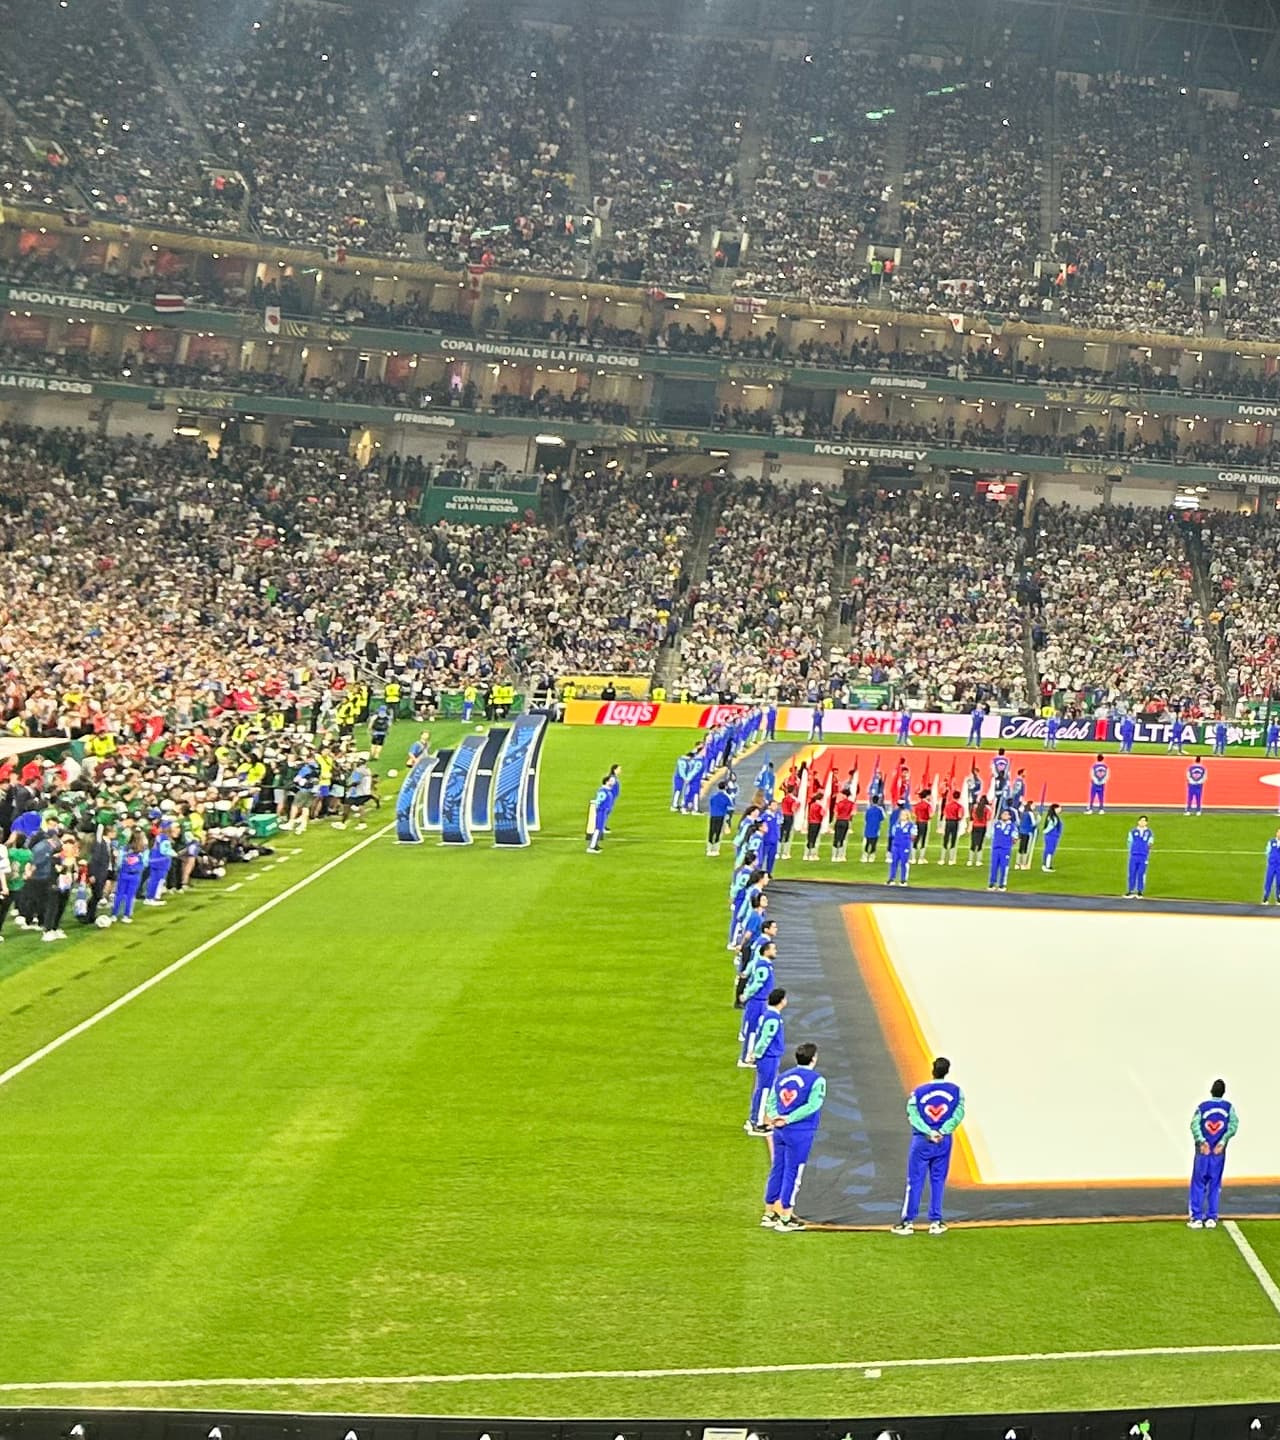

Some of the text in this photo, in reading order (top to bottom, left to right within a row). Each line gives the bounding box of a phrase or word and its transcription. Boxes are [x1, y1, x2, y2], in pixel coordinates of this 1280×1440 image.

[9, 289, 131, 314] MONTERREY
[440, 338, 474, 353] COPA
[476, 340, 530, 358] MUNDIAL
[532, 347, 547, 360] DE
[551, 349, 566, 361] LA
[568, 350, 593, 364] FIFA
[18, 377, 46, 390] FIFA
[814, 443, 928, 461] MONTERREY
[1218, 472, 1247, 484] COPA
